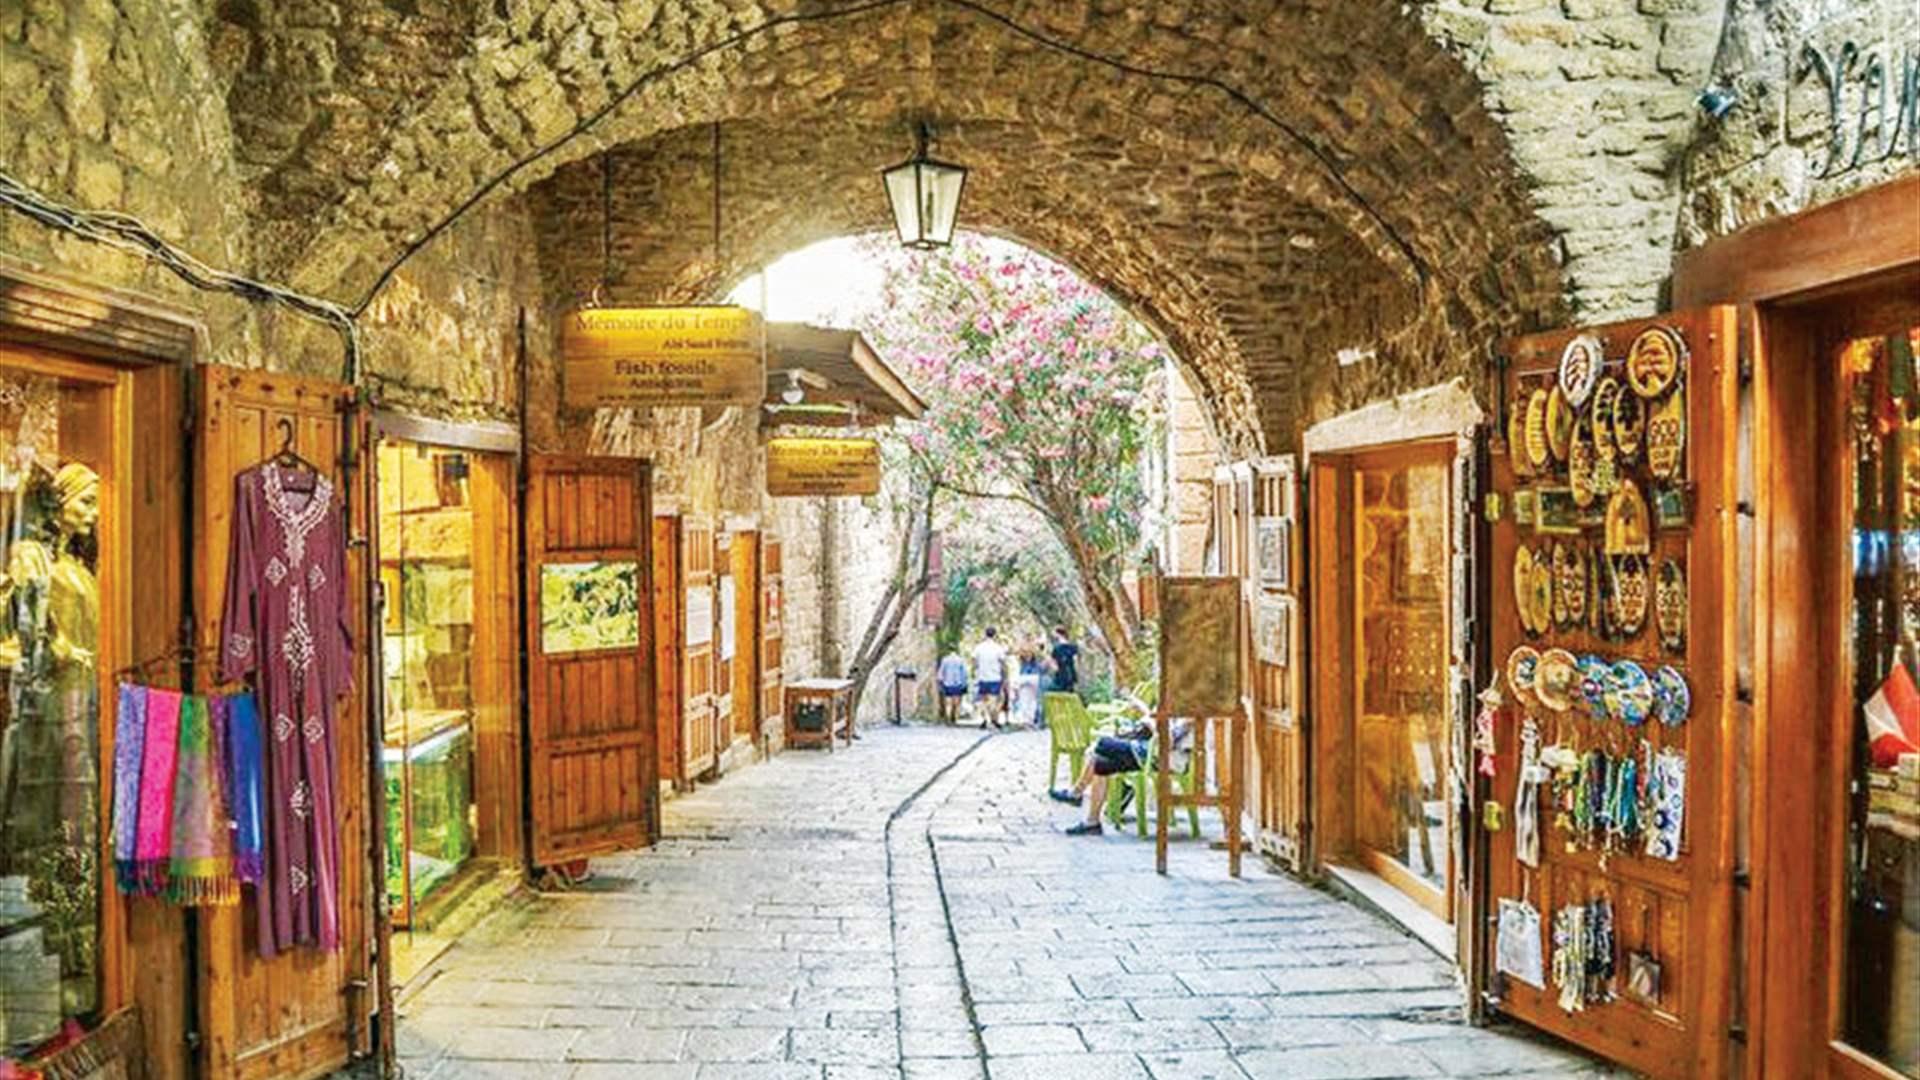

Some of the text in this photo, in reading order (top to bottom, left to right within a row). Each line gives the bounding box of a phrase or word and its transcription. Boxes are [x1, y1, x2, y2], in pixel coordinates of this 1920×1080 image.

[662, 313, 686, 330] du
[614, 358, 716, 376] Fish fossils
